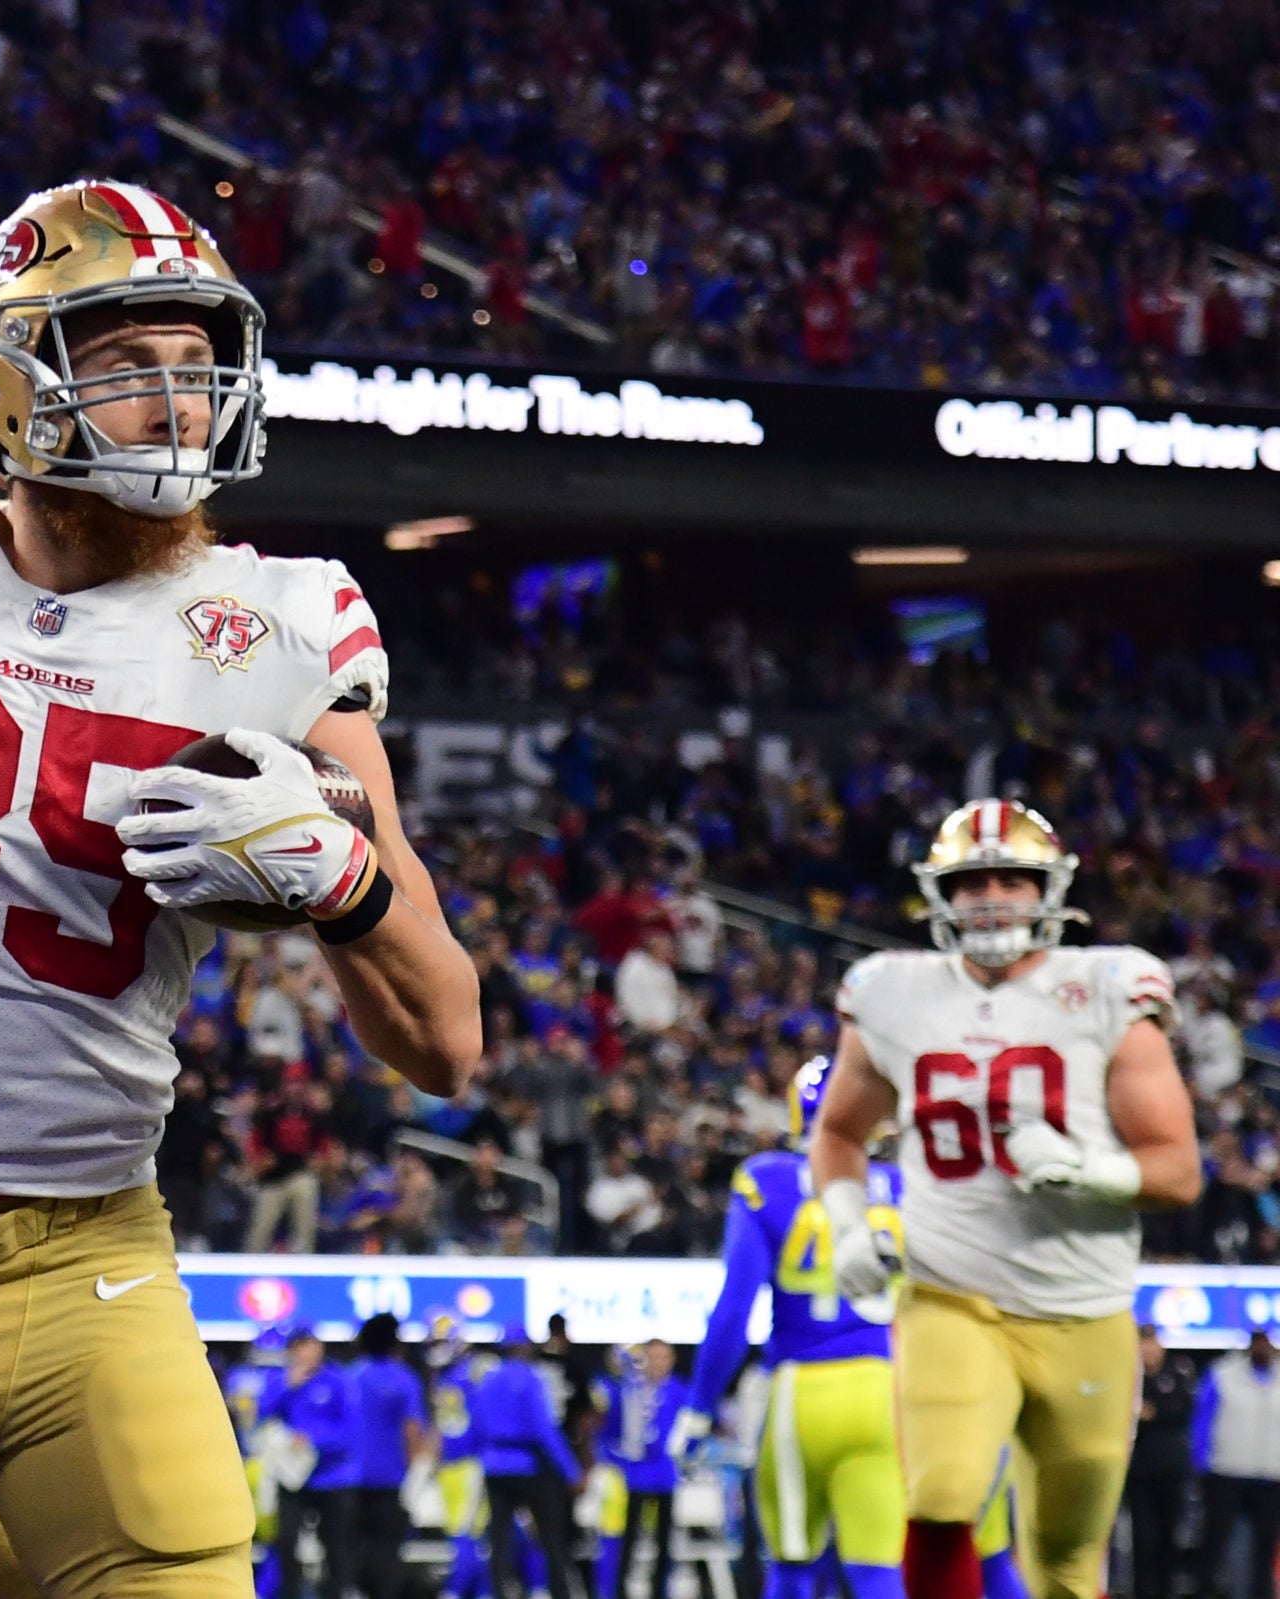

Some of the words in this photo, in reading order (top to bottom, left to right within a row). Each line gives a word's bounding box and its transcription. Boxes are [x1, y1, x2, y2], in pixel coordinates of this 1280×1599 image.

[357, 364, 466, 435] right
[464, 373, 535, 432] for
[528, 375, 622, 436] The
[934, 398, 1094, 462] Official
[1095, 405, 1260, 470] Partner
[34, 610, 59, 632] NFL
[202, 607, 250, 652] 75
[915, 1046, 1067, 1181] 60
